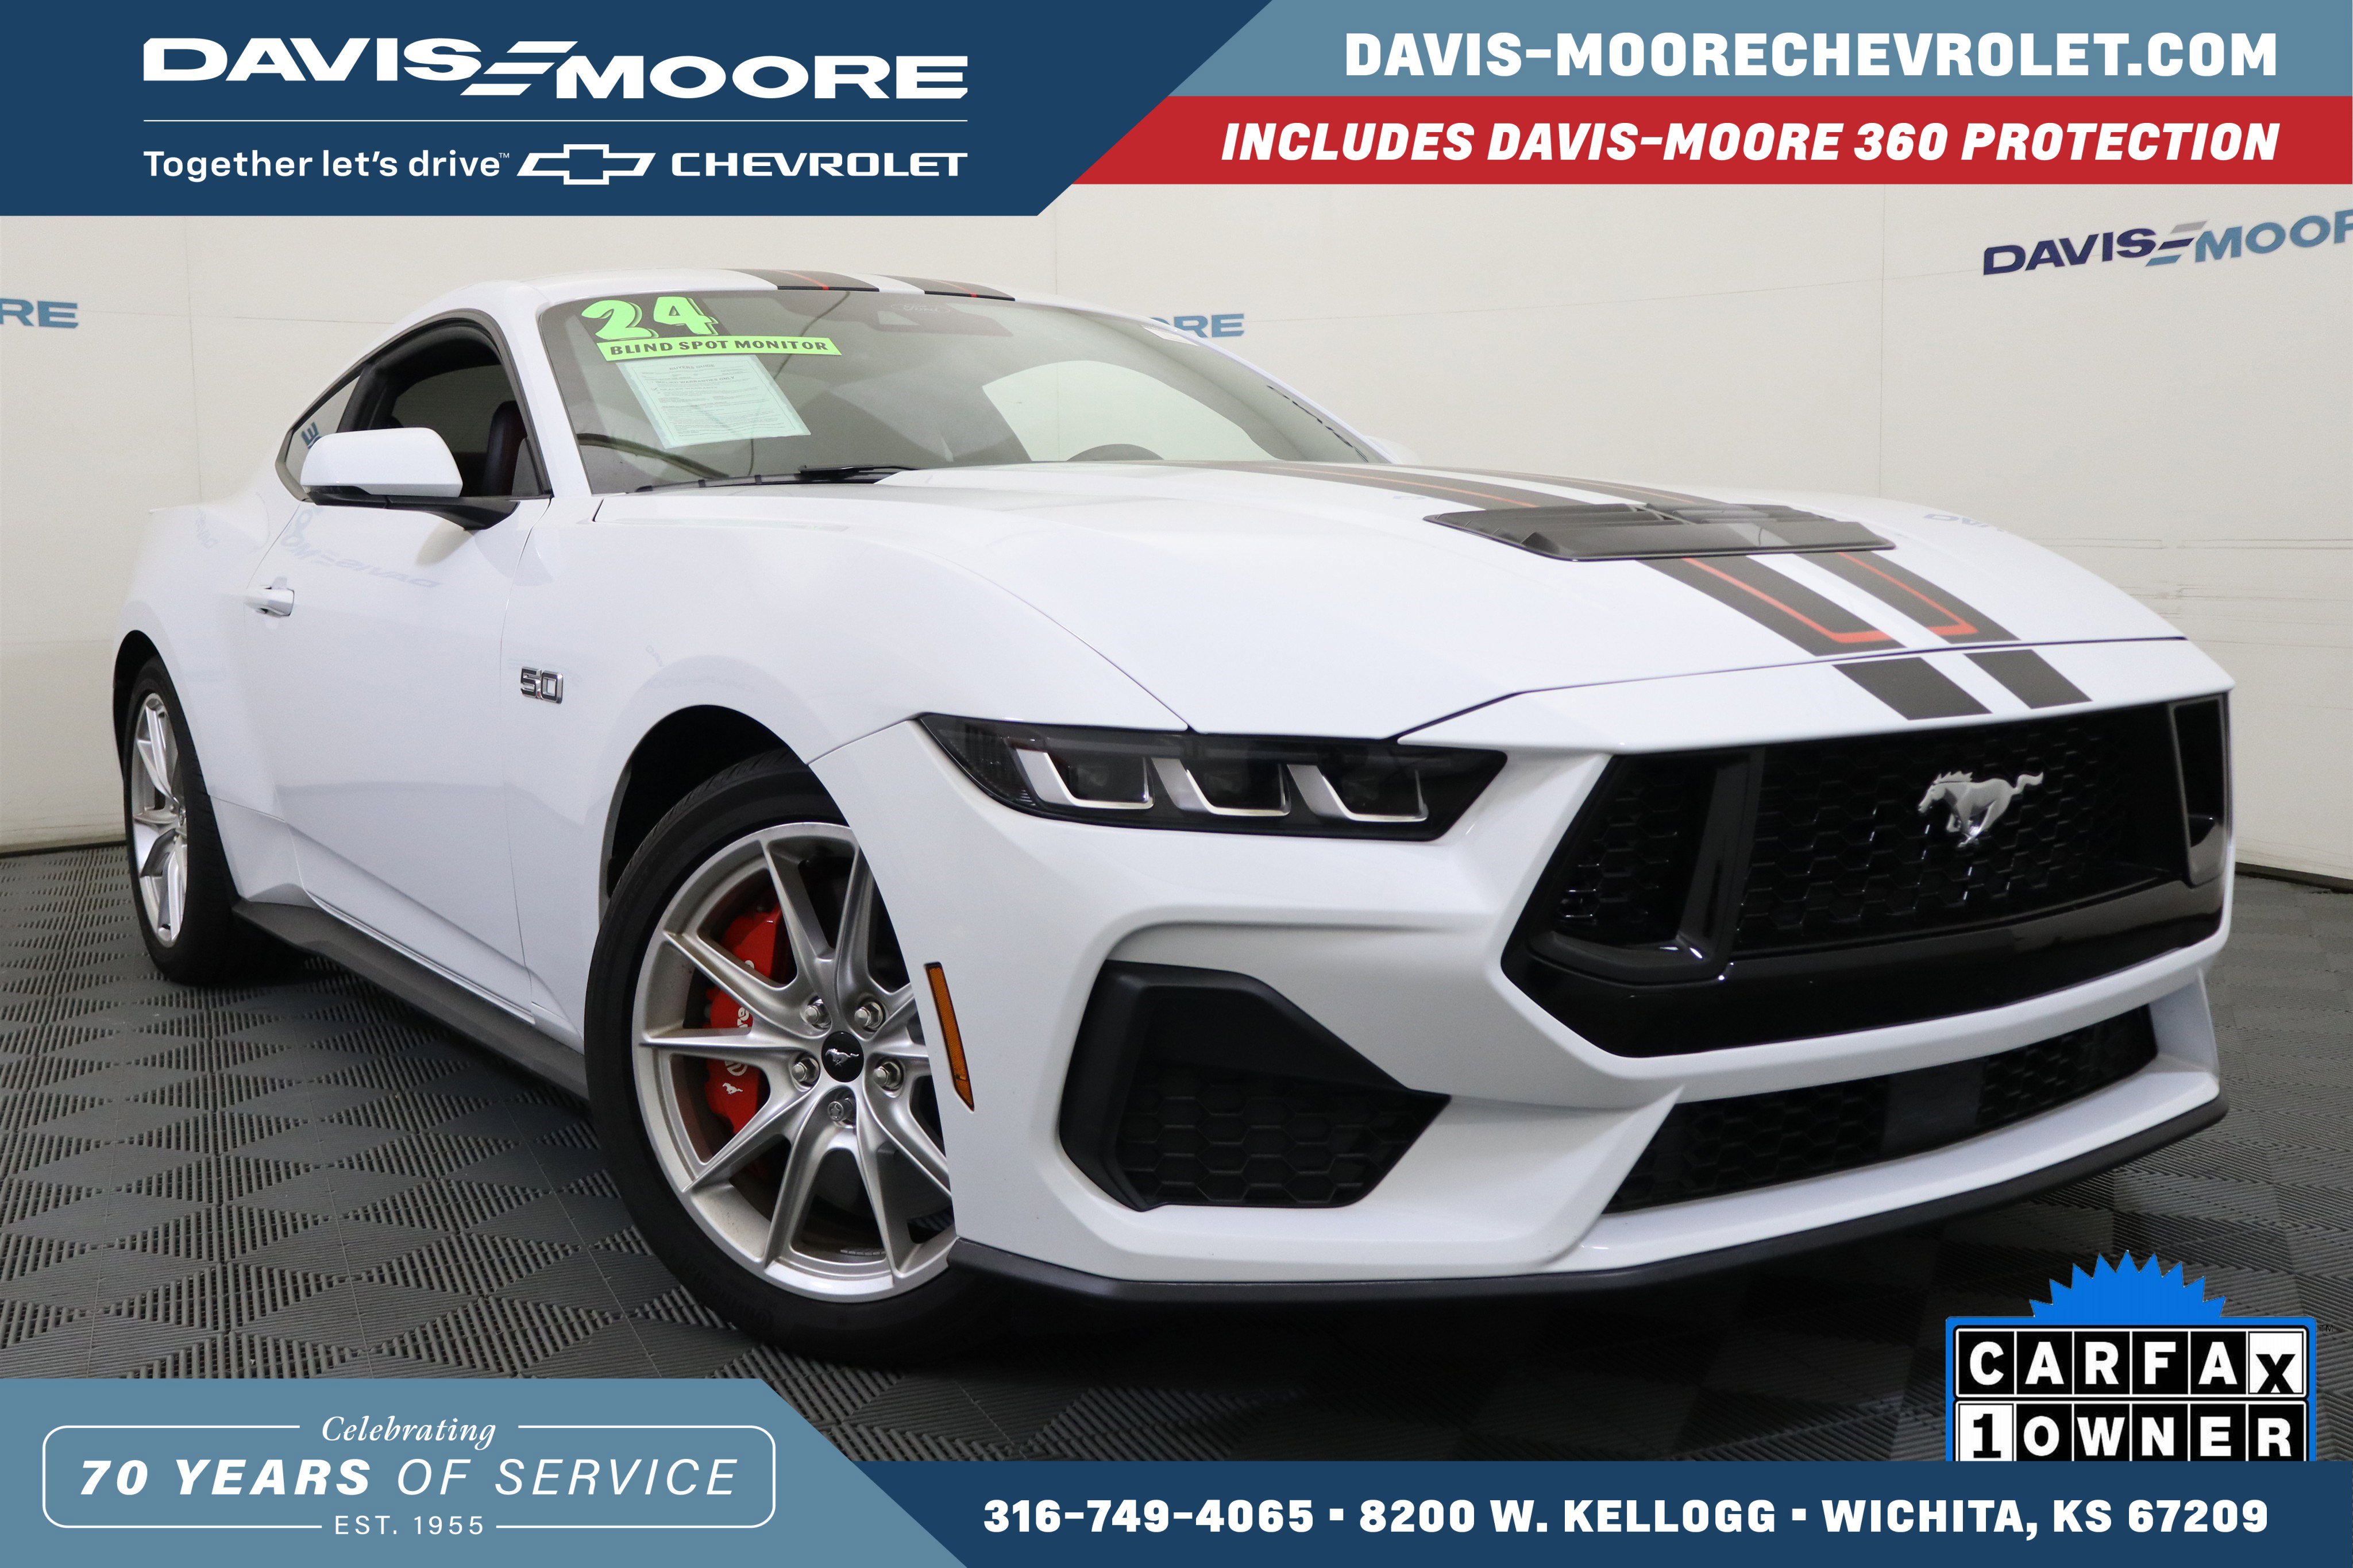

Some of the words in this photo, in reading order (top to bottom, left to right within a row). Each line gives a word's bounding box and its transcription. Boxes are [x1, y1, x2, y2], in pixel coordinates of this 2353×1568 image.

[1982, 228, 2157, 276] DAVIS
[581, 296, 719, 341] 24
[1149, 313, 1245, 338] RE
[610, 342, 673, 356] BLIND
[680, 340, 728, 351] SPOT
[735, 340, 828, 351] MONITOR
